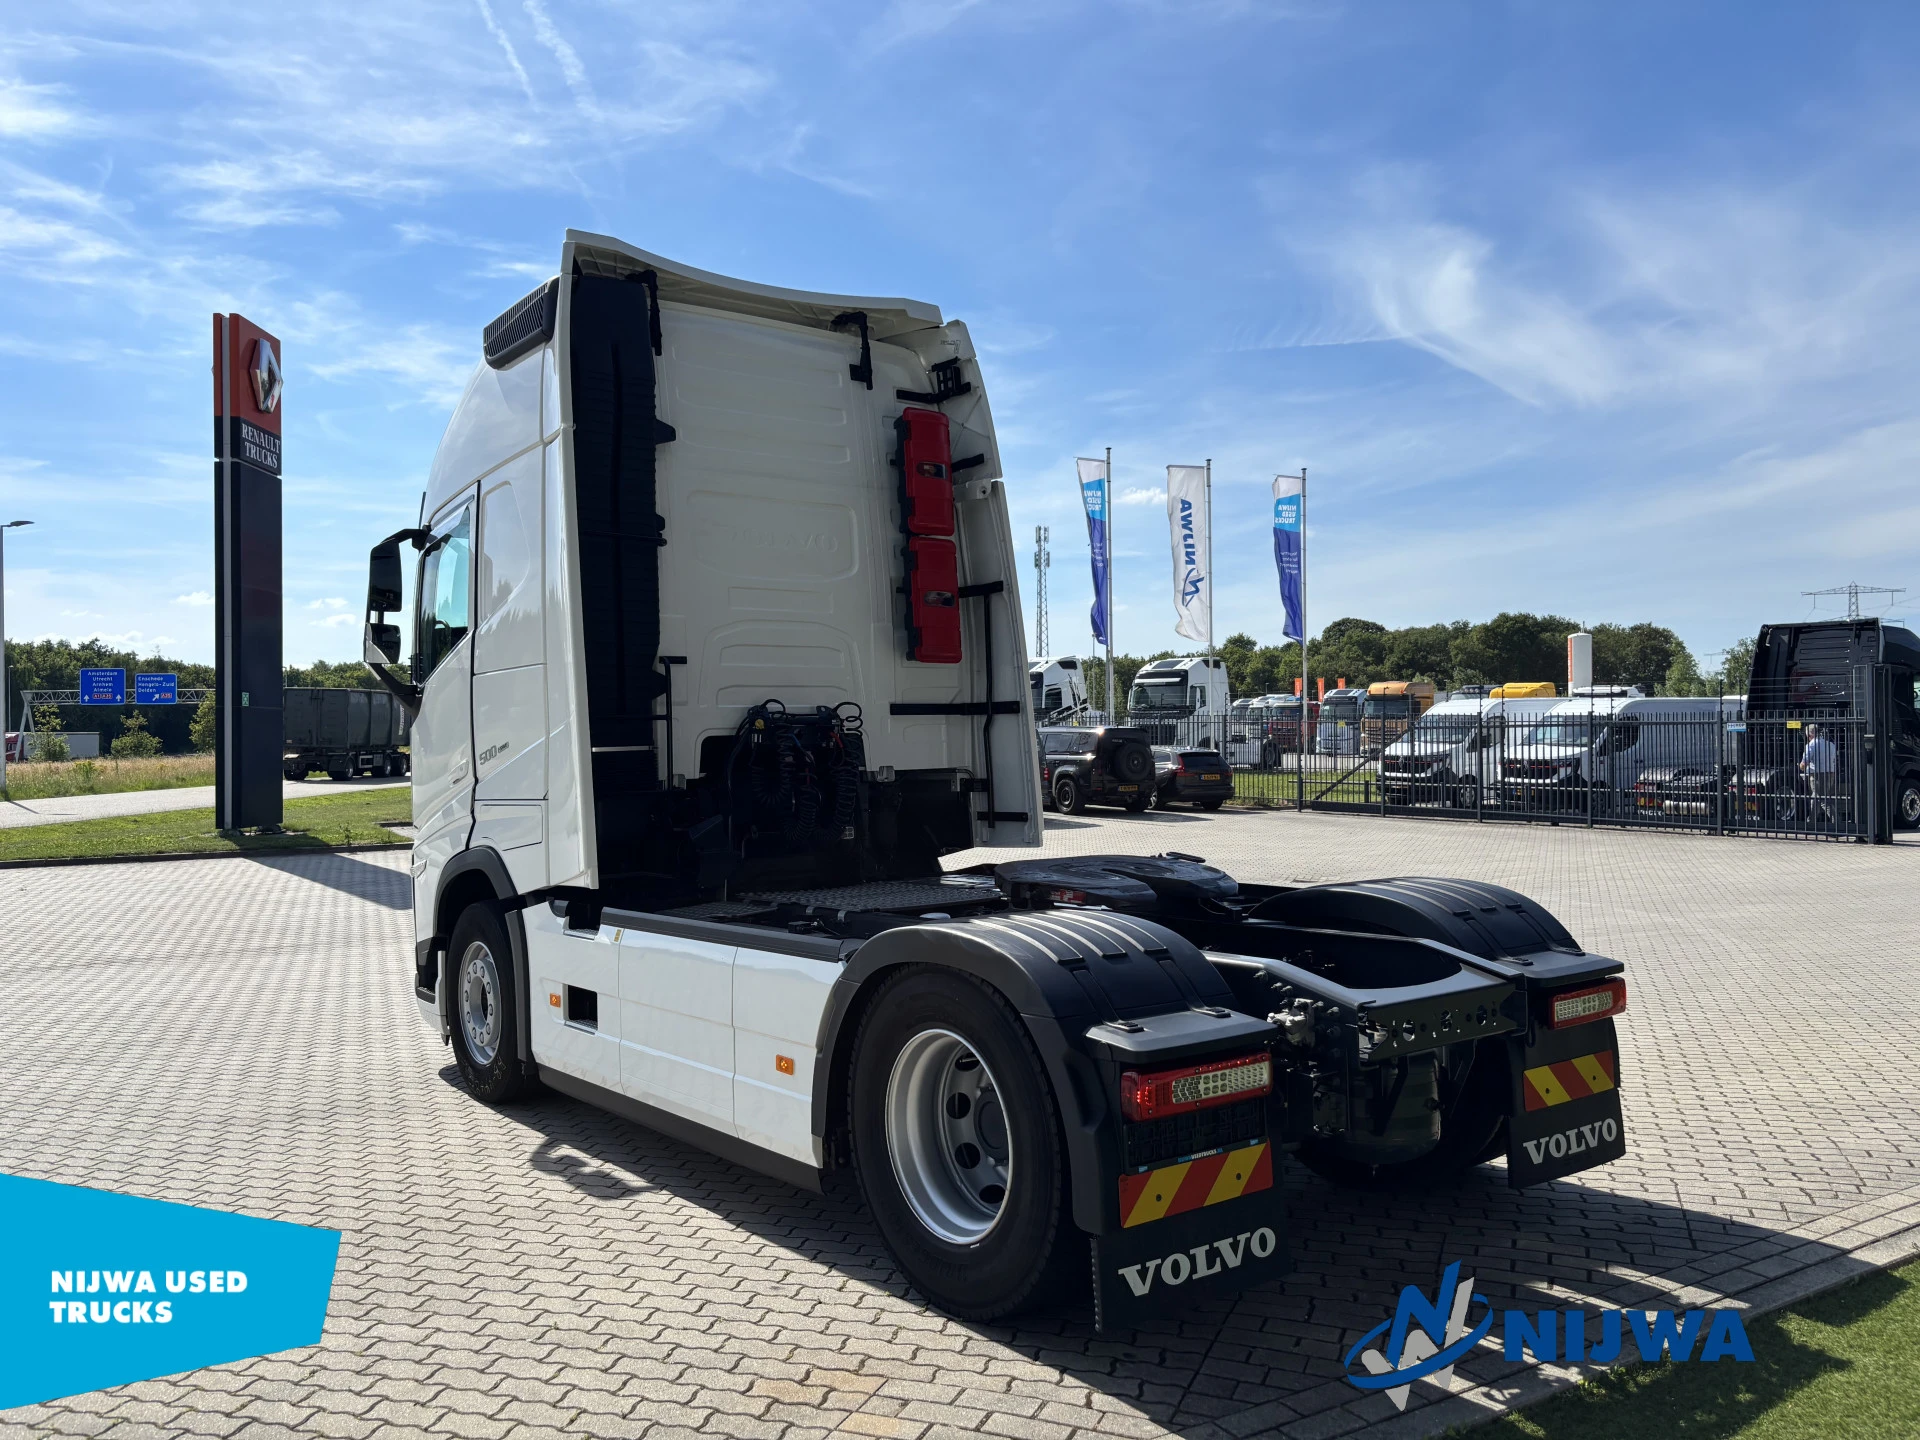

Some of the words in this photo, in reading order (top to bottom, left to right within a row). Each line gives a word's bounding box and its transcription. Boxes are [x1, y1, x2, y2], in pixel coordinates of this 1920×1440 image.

[241, 422, 281, 454] RENAULT
[244, 441, 278, 469] TRUCKS
[479, 744, 498, 766] 500
[1522, 1117, 1617, 1165] VOLVO
[1117, 1226, 1276, 1297] VOLVO
